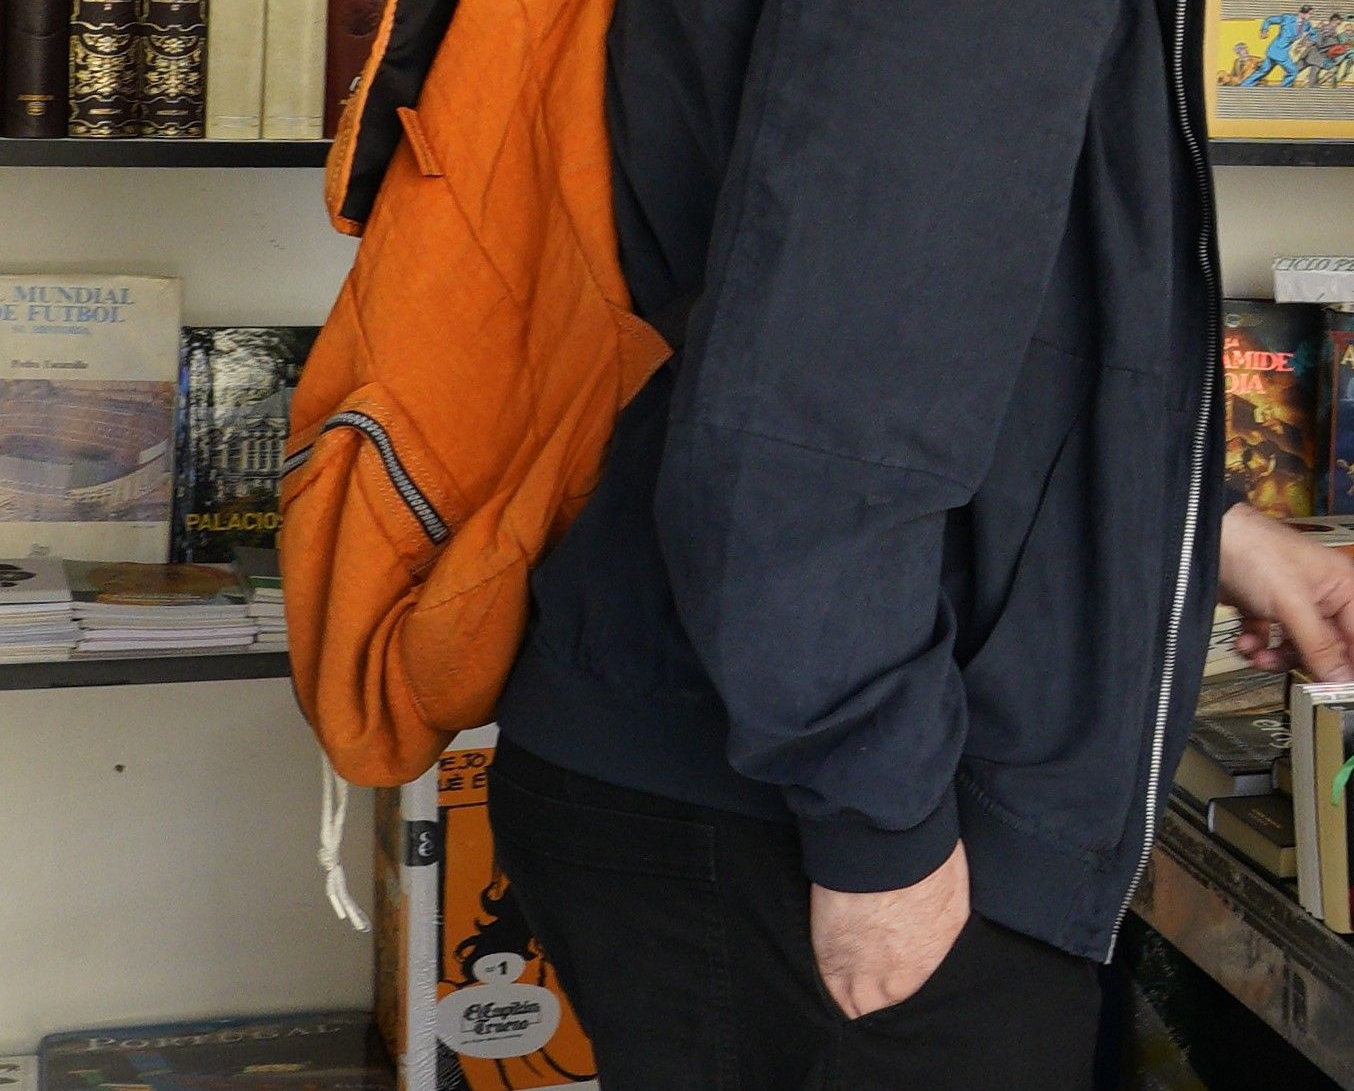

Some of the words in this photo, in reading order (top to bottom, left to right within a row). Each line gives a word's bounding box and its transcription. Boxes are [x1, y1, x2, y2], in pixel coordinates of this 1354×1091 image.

[1275, 258, 1331, 272] CICLO
[12, 286, 135, 305] MUNDIAL
[28, 305, 126, 323] FUTBOL
[88, 1021, 343, 1053] PORTUGAL
